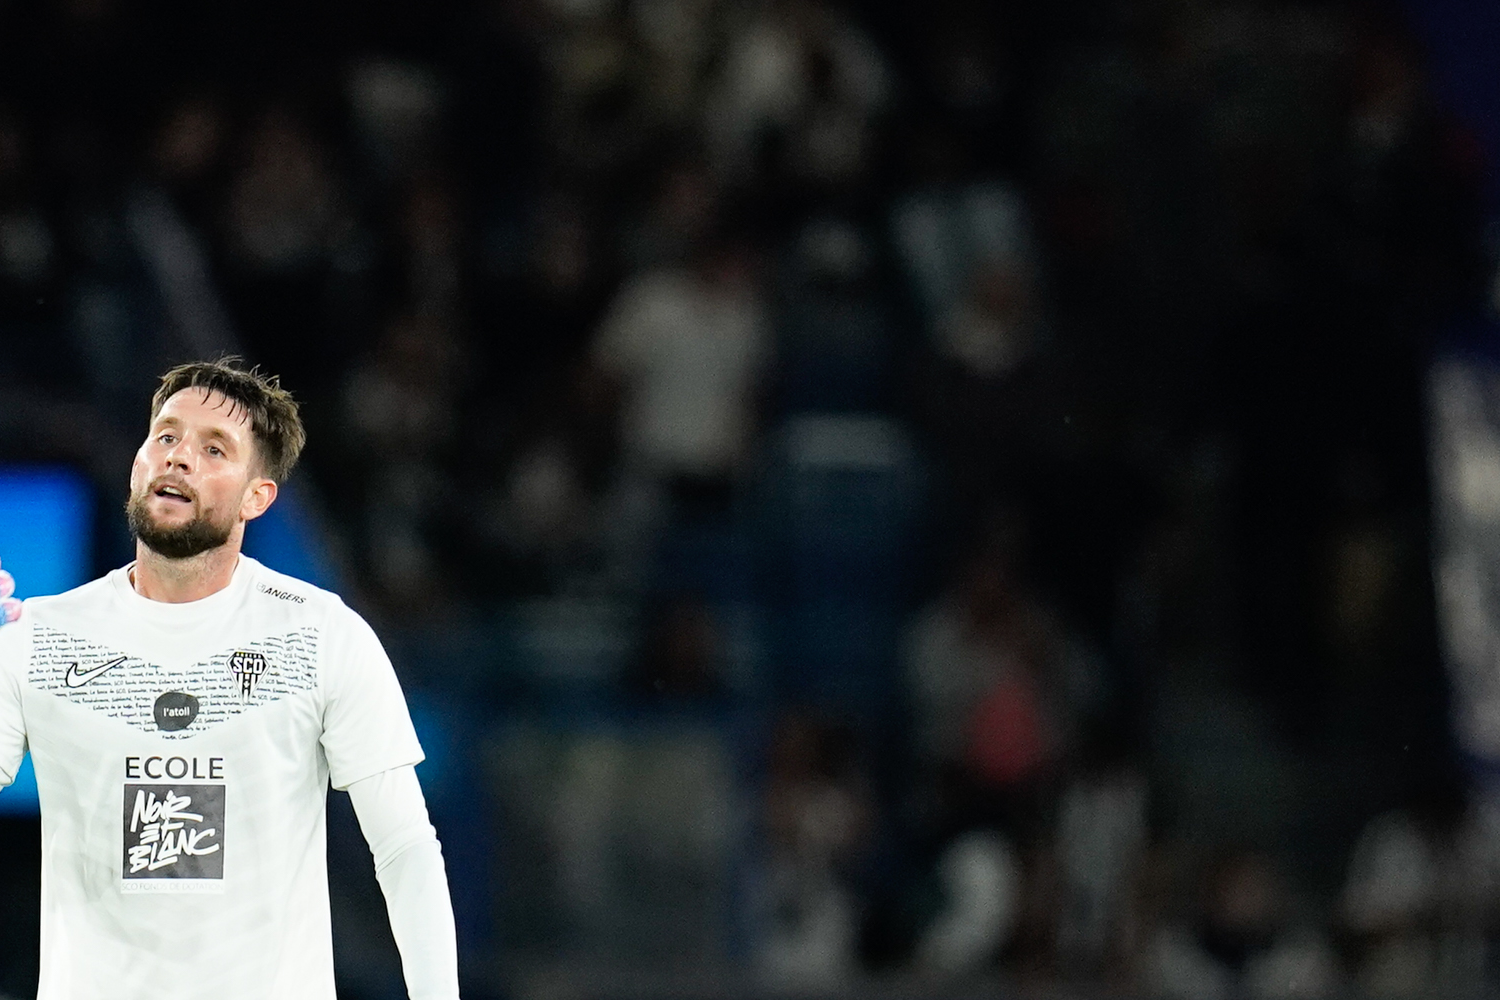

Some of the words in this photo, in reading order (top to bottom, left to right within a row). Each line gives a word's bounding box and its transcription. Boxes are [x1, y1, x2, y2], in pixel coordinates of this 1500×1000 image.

[264, 587, 307, 605] ANGERS
[232, 656, 264, 676] SCO
[163, 706, 190, 717] l'atoll
[125, 756, 224, 780] ECOLE
